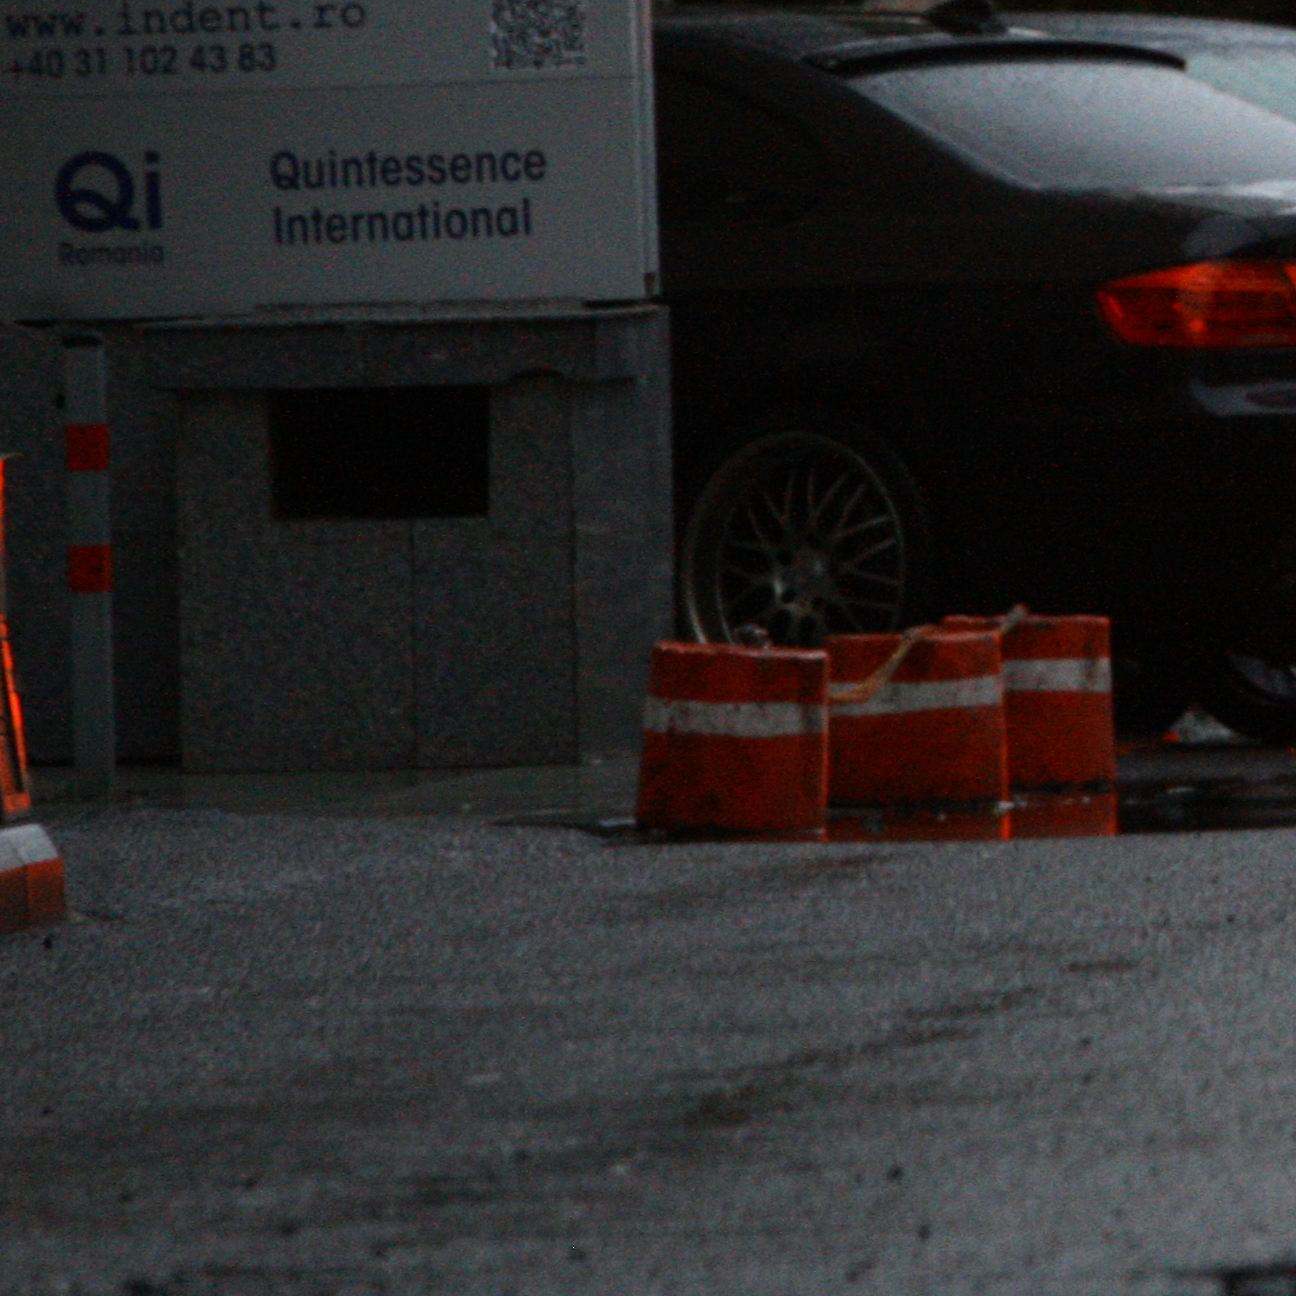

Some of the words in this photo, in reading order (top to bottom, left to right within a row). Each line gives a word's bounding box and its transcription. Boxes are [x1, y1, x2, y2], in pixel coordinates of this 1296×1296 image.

[2, 49, 66, 79] +40
[74, 47, 107, 77] 31
[126, 44, 179, 75] 102
[189, 43, 228, 73] 43
[238, 42, 278, 72] 83
[55, 150, 163, 233] Qi
[270, 147, 547, 191] Quintessence
[273, 199, 532, 245] International
